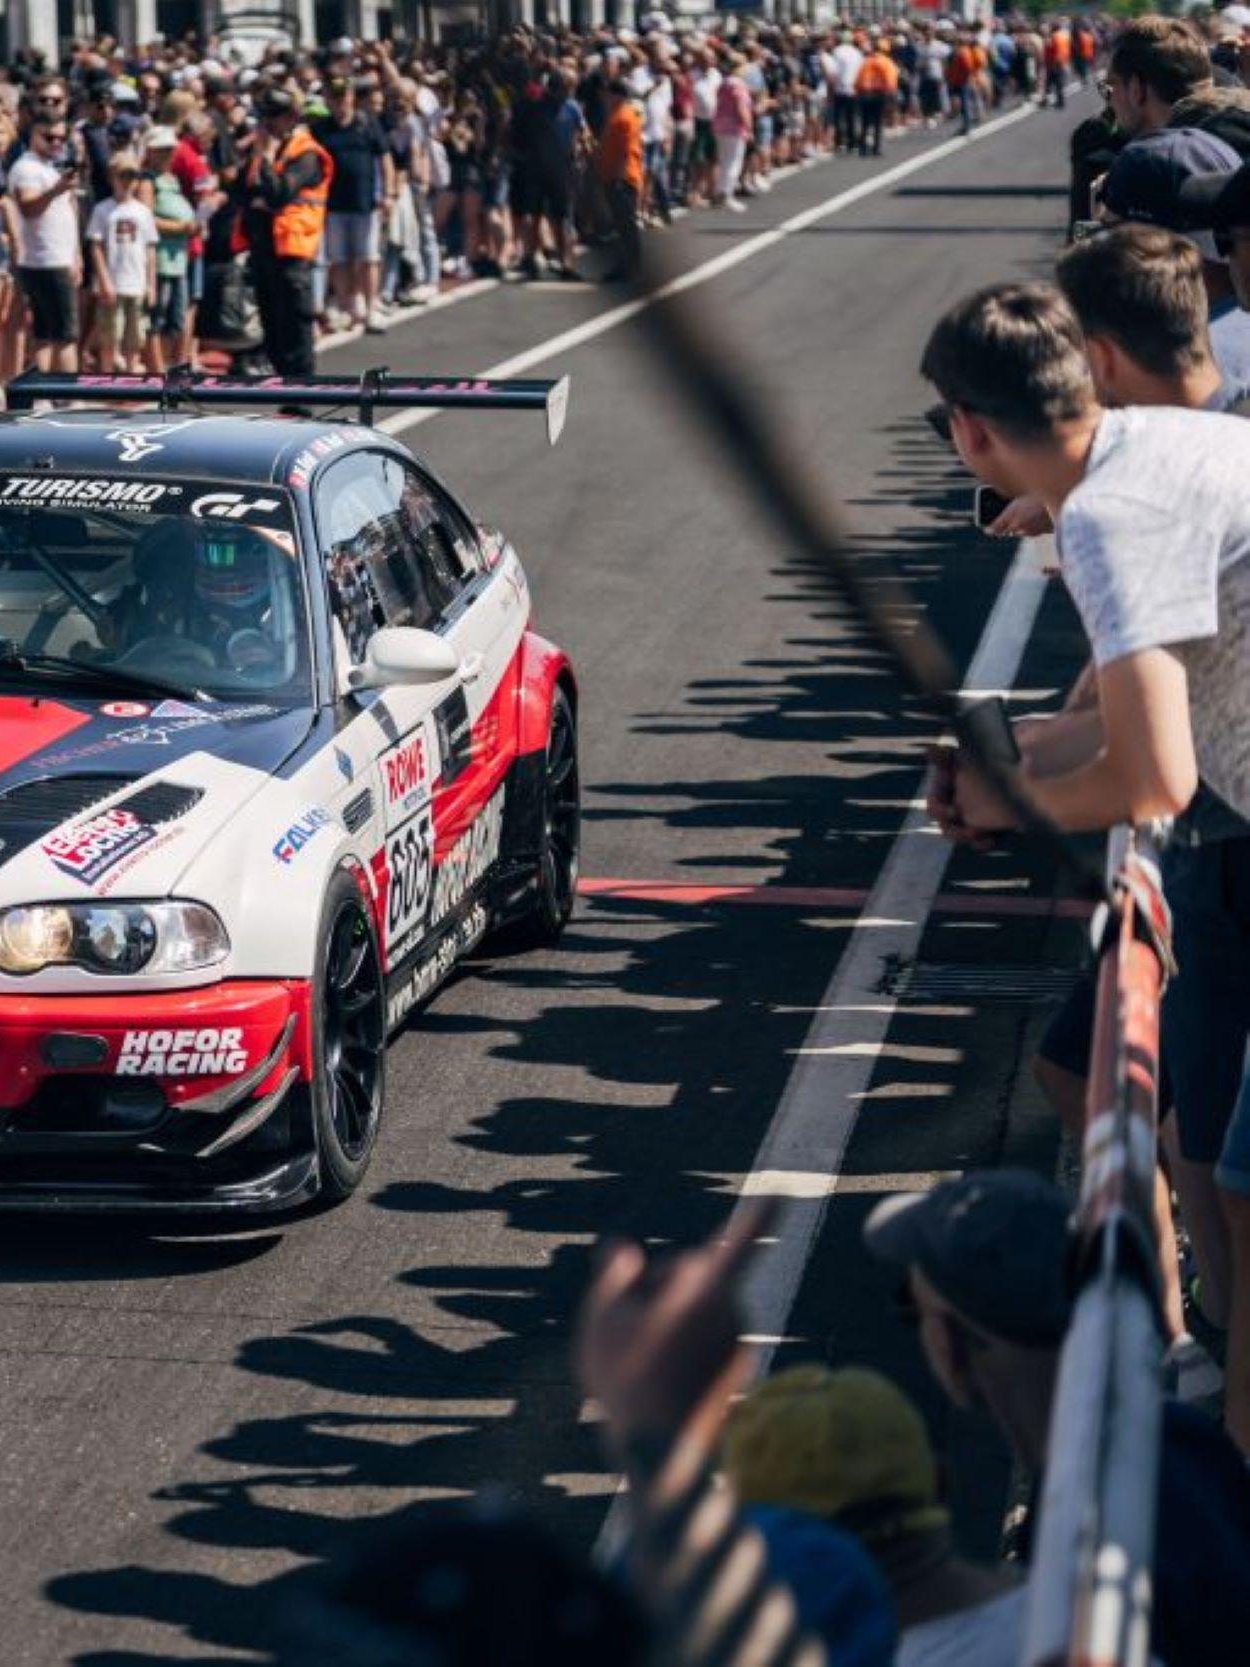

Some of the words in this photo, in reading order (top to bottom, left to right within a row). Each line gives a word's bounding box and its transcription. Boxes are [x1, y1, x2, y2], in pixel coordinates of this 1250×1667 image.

[386, 737, 426, 802] ROWE
[390, 816, 430, 933] 605
[115, 1050, 248, 1075] RACING
[122, 1027, 244, 1055] HOFOR
